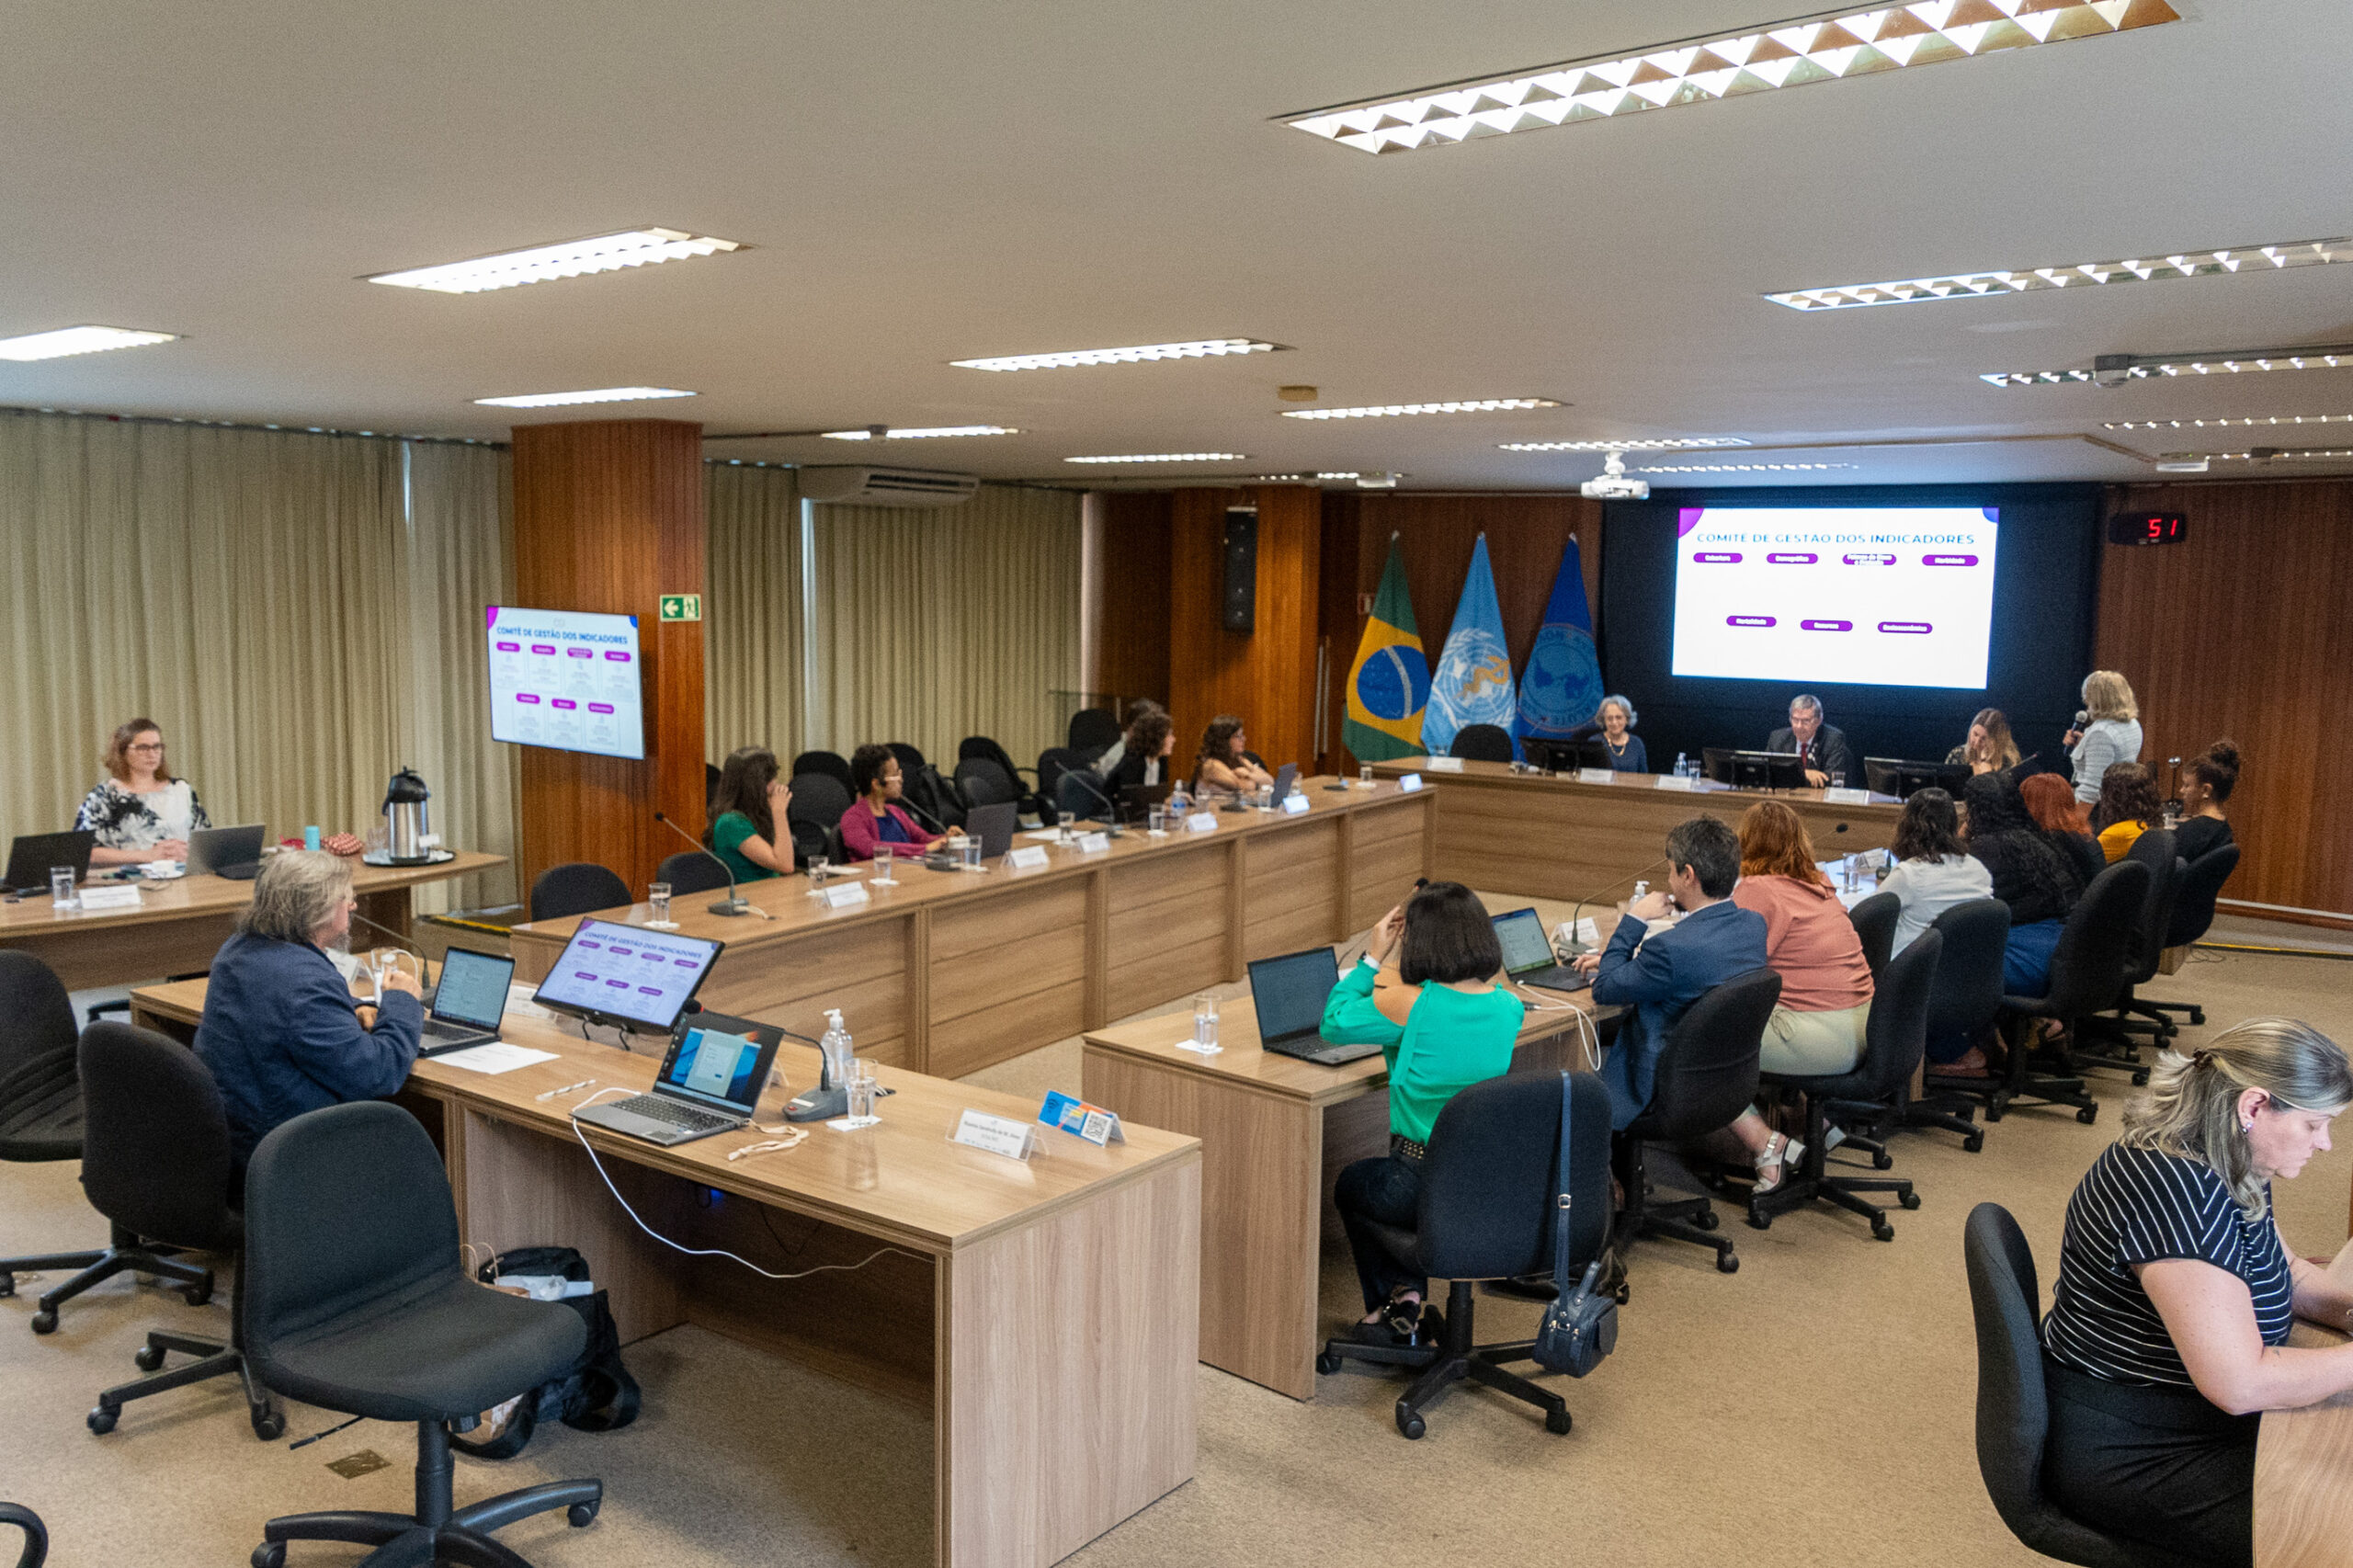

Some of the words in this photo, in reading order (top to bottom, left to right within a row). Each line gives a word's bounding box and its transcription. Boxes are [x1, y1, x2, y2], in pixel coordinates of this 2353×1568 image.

[2148, 518, 2177, 538] 51
[1752, 533, 1769, 543] DE
[1836, 533, 1866, 544] DOS
[1870, 533, 1975, 545] INDICADORES
